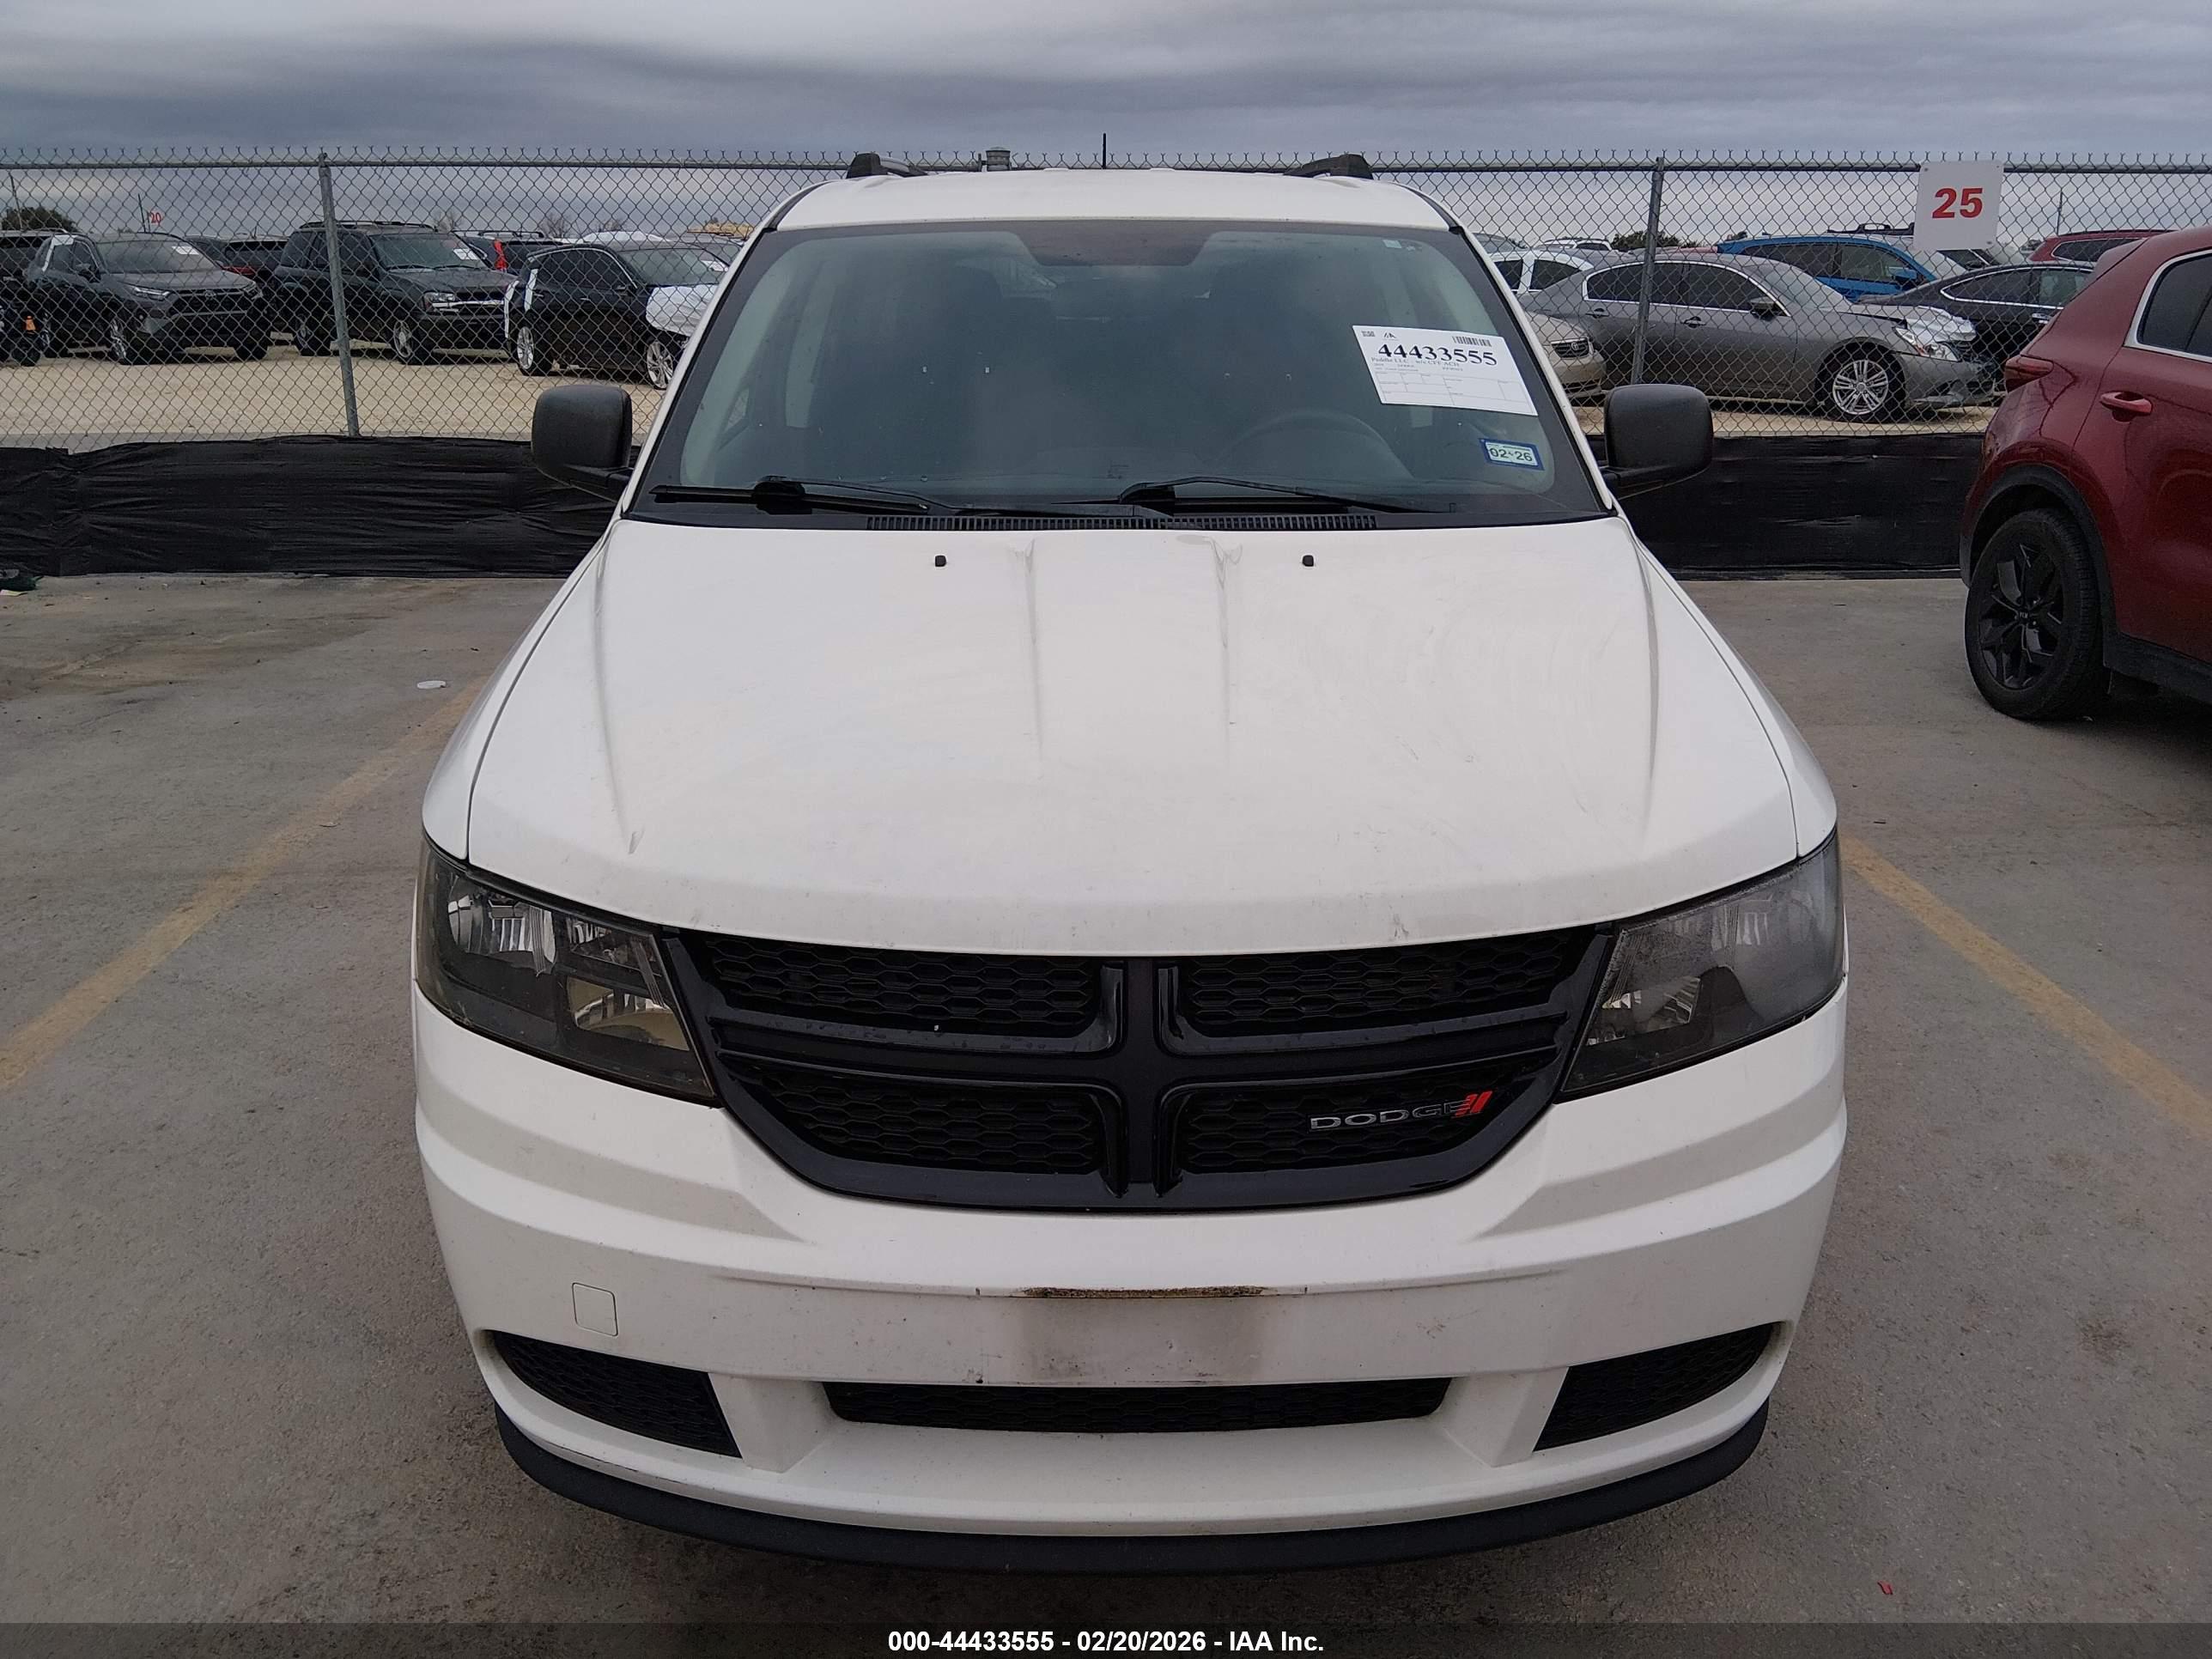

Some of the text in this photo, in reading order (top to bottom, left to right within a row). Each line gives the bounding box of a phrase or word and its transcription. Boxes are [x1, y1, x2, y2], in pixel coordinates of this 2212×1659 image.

[1931, 187, 1984, 219] 25
[149, 211, 162, 224] 20
[1378, 343, 1498, 366] 44433555
[1310, 1098, 1471, 1130] DODGE
